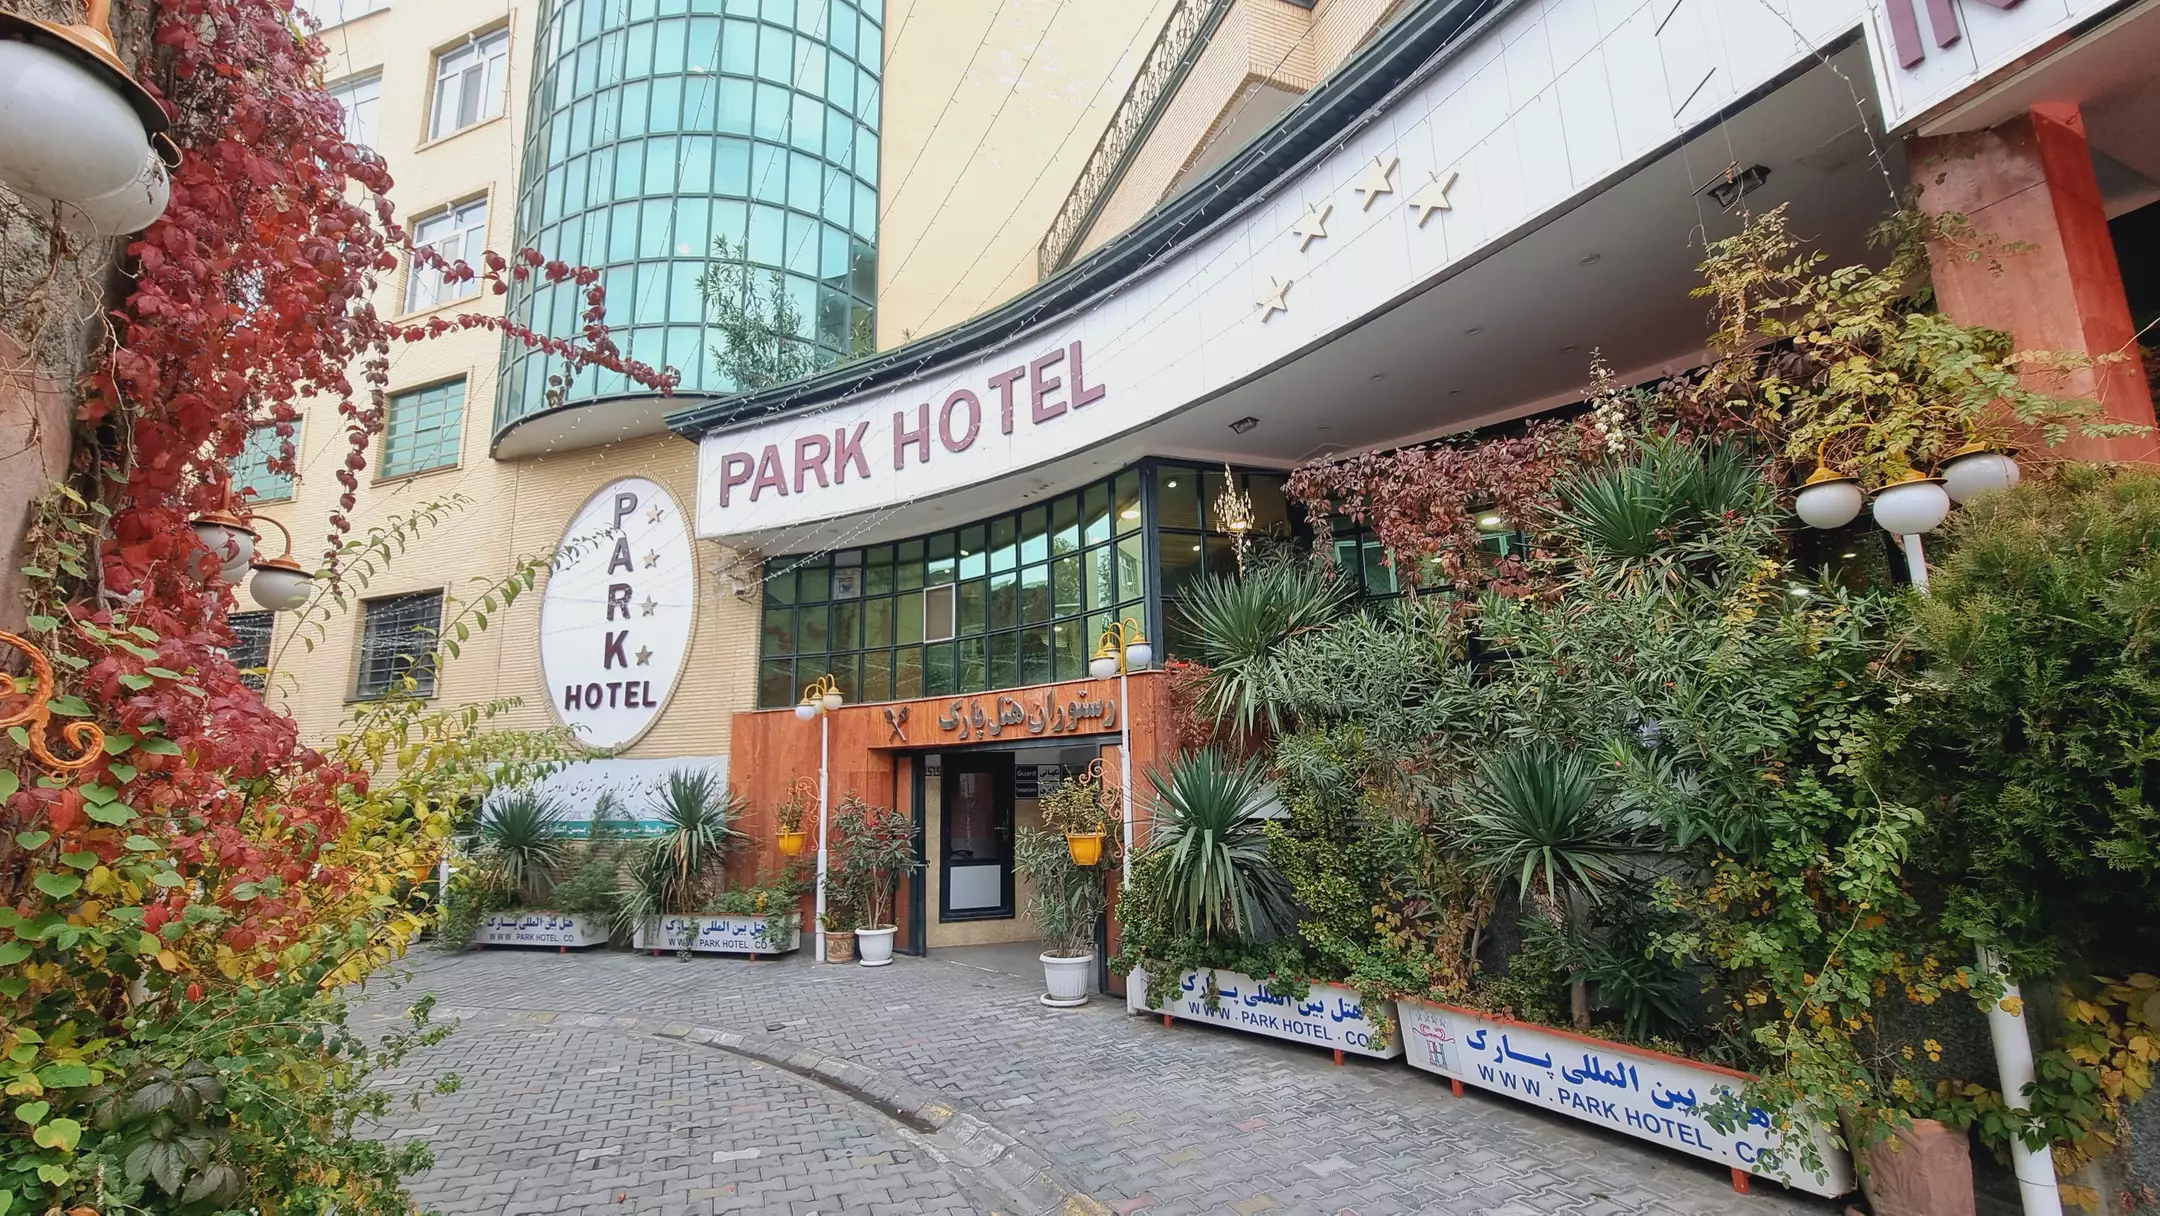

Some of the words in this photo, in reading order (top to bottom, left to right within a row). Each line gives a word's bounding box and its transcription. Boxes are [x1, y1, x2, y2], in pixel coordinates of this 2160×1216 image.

[719, 421, 871, 508] PARK
[894, 340, 1106, 470] HOTEL
[603, 492, 638, 670] PARK
[564, 680, 657, 711] HOTEL
[1028, 687, 1117, 734] رستوران
[939, 697, 985, 740] پارک
[988, 696, 1025, 736] هتل
[559, 917, 574, 930] هتل
[702, 920, 730, 936] المللی
[732, 922, 747, 936] بین
[723, 939, 748, 949] HOTEL
[1241, 1011, 1279, 1031] PARK
[1283, 1018, 1333, 1041] HOTEL
[1331, 998, 1364, 1022] هتل
[1467, 1029, 1554, 1079] پارک
[1562, 1053, 1639, 1092] المللی
[1651, 1081, 1697, 1116] بین
[1558, 1087, 1621, 1122] PARK
[1624, 1106, 1713, 1151] HOTEL
